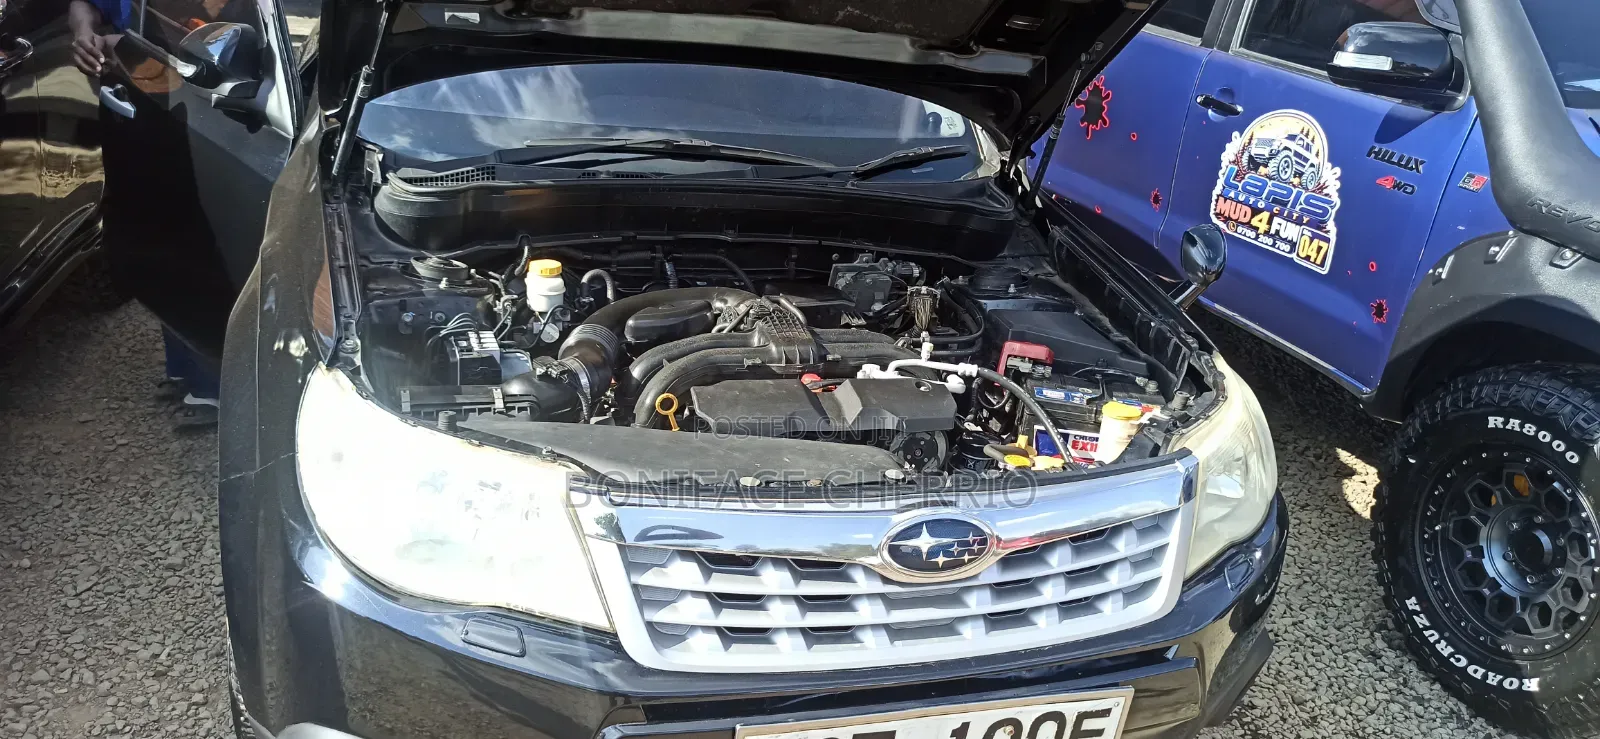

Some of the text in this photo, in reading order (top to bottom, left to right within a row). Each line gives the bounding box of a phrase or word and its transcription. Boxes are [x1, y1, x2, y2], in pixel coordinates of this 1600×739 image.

[1366, 145, 1426, 174] HILUX
[1376, 176, 1417, 195] 4WD
[1216, 196, 1301, 243] MUD 4 FUN
[1228, 190, 1310, 224] AUTO CITY
[1237, 226, 1291, 252] 0700 200 700
[1298, 235, 1329, 265] 047
[1487, 416, 1579, 464] RA8000
[1405, 596, 1540, 692] ROADCRUZA
